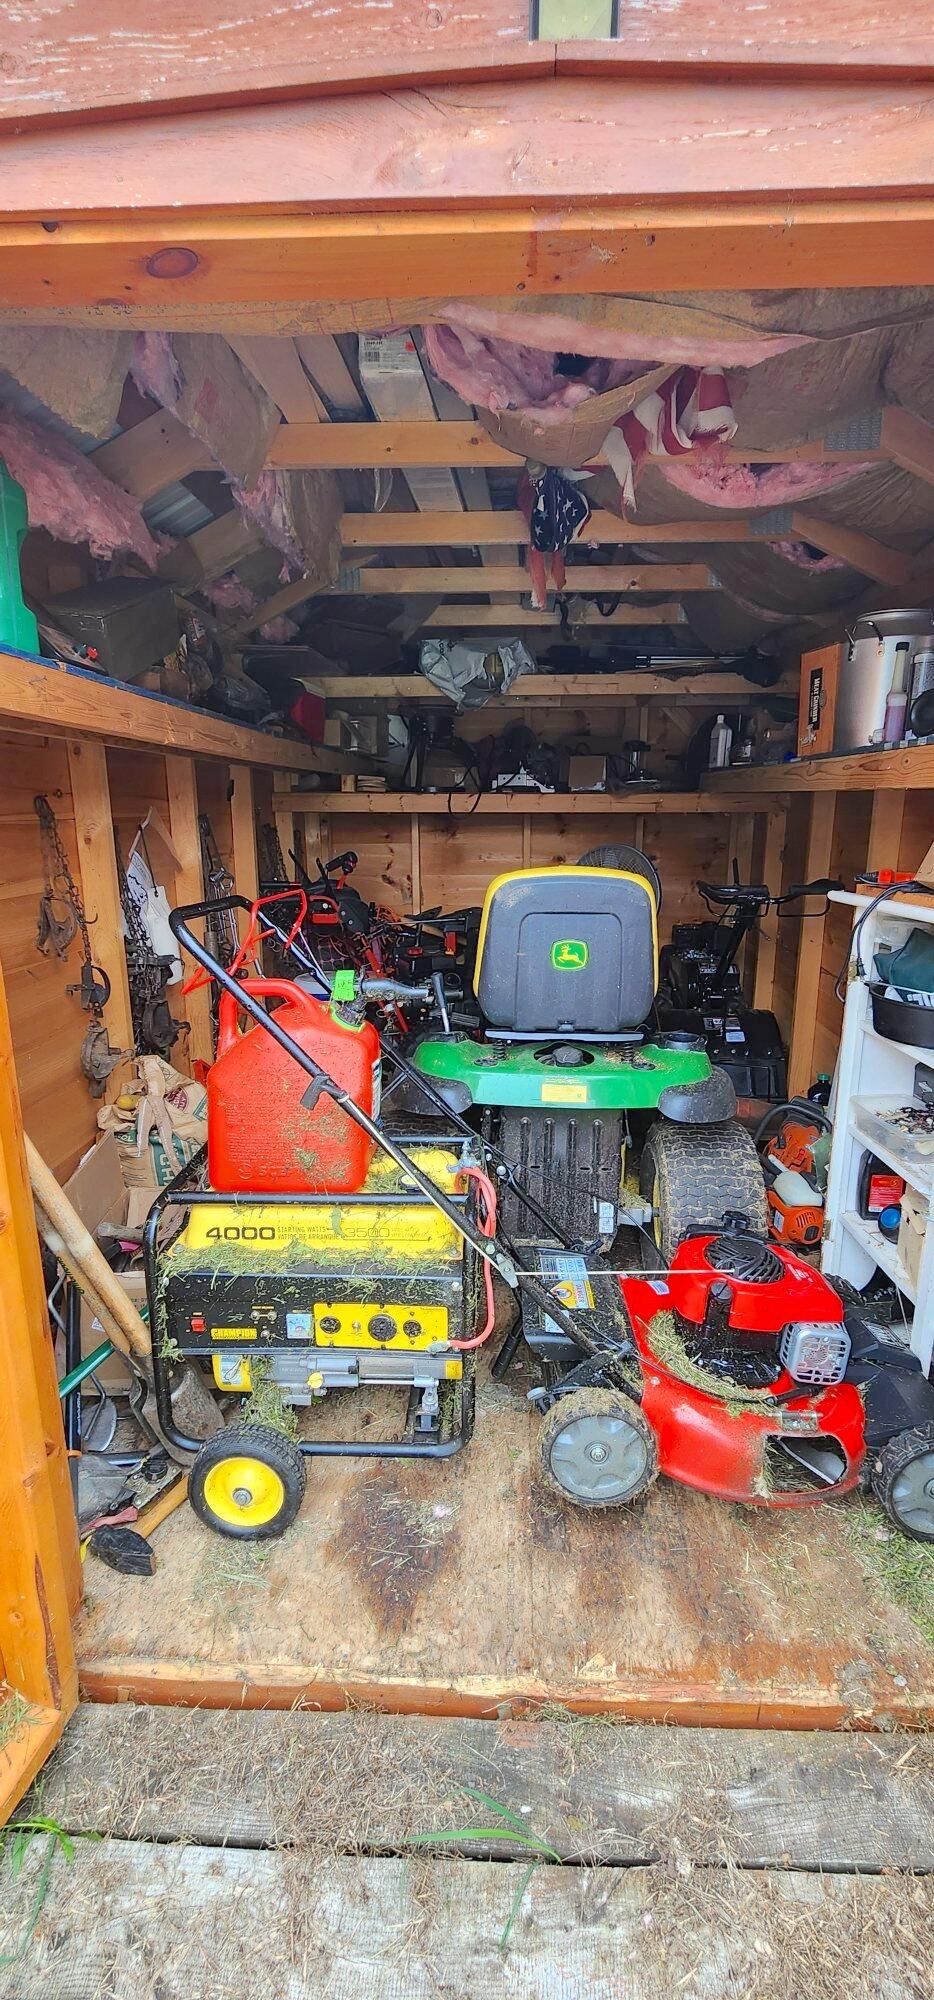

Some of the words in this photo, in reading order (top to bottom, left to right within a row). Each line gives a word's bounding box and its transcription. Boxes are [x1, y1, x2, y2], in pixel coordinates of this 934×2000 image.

[206, 1227, 275, 1240] 4000
[344, 1227, 391, 1238] 3500
[211, 1327, 257, 1340] CHAMPION
